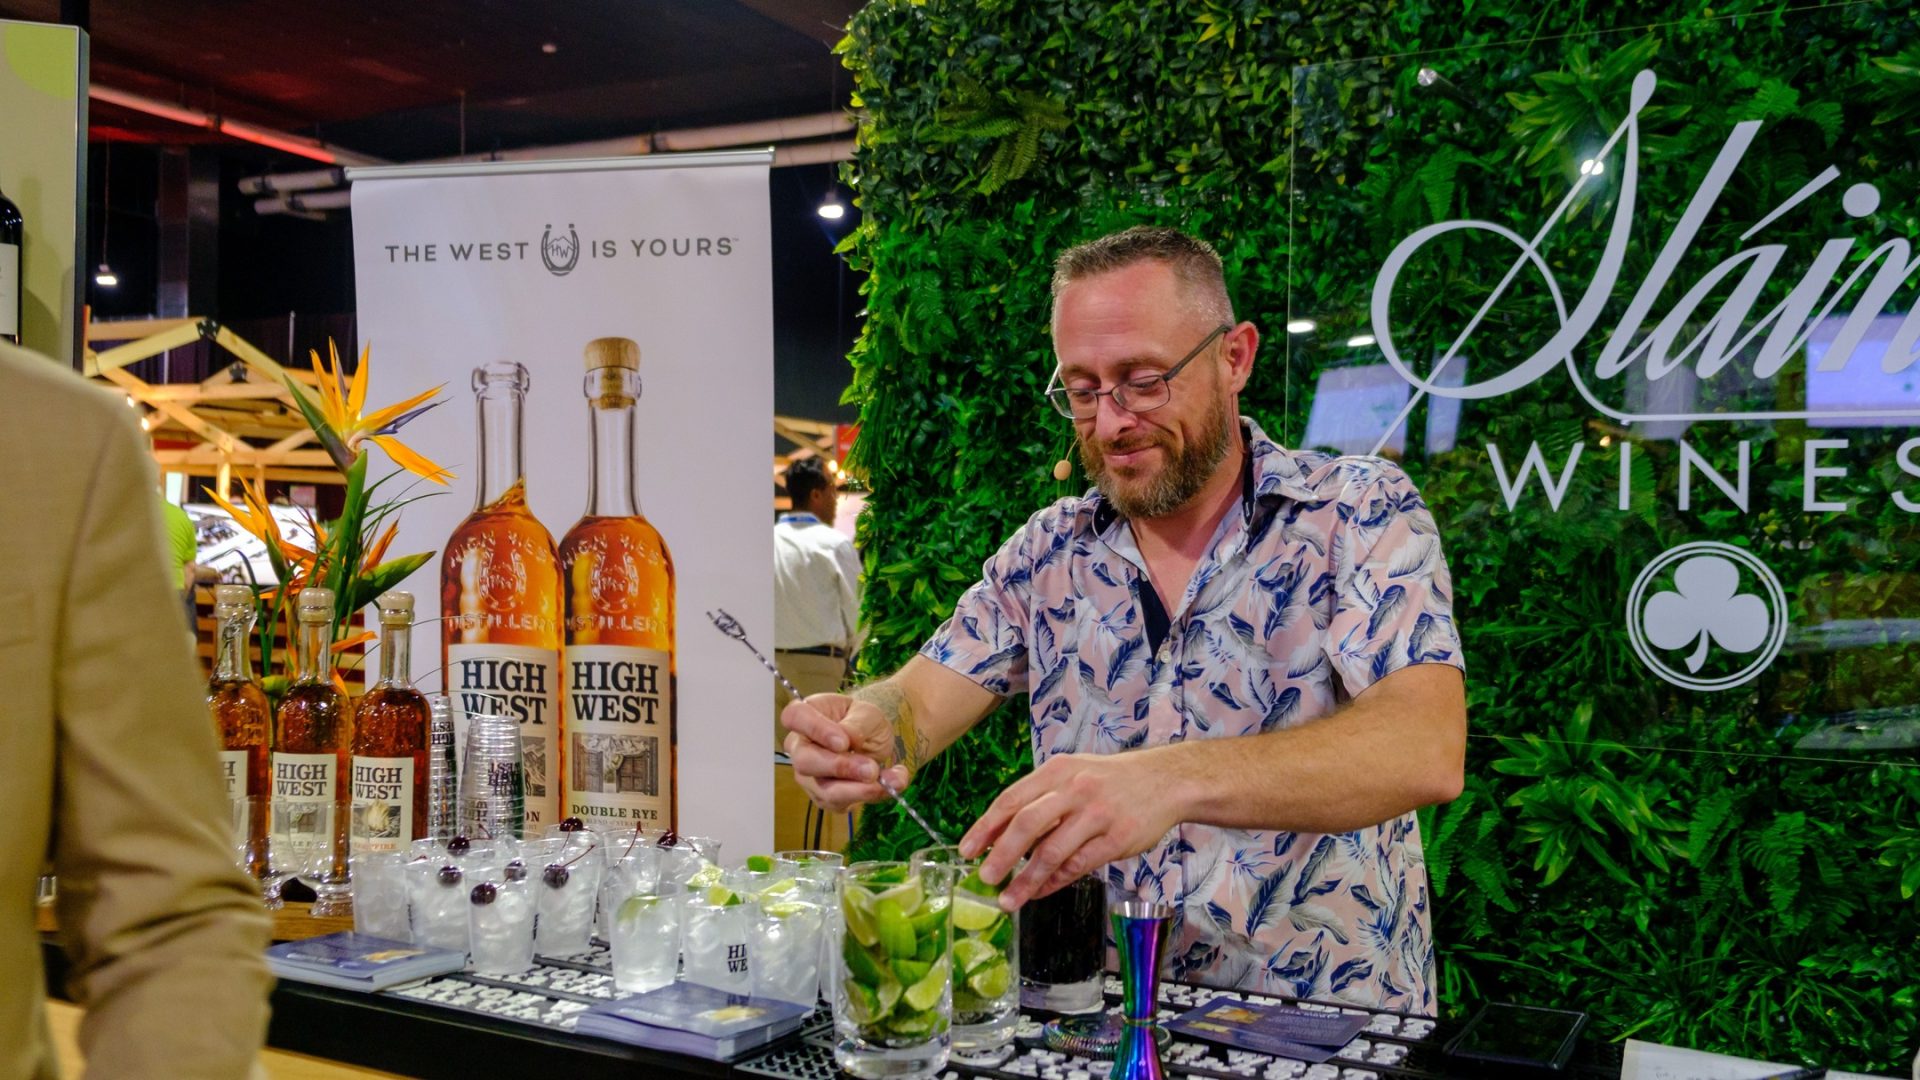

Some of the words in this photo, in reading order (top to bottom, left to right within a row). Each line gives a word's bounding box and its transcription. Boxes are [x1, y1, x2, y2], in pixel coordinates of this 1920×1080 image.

[386, 244, 437, 262] THE
[449, 241, 529, 261] WEST
[592, 239, 617, 258] IS
[1486, 438, 1920, 514] WINES
[461, 660, 547, 694] HIGH
[572, 661, 659, 695] HIGH
[461, 693, 547, 725] WEST
[572, 694, 659, 725] WEST
[277, 763, 328, 780] HIGH
[355, 766, 403, 783] HIGH
[277, 781, 327, 796] WEST
[355, 784, 402, 800] WEST
[572, 804, 627, 818] DOUBLE
[632, 808, 658, 820] RYE
[728, 944, 747, 959] HI
[728, 959, 748, 973] WE
